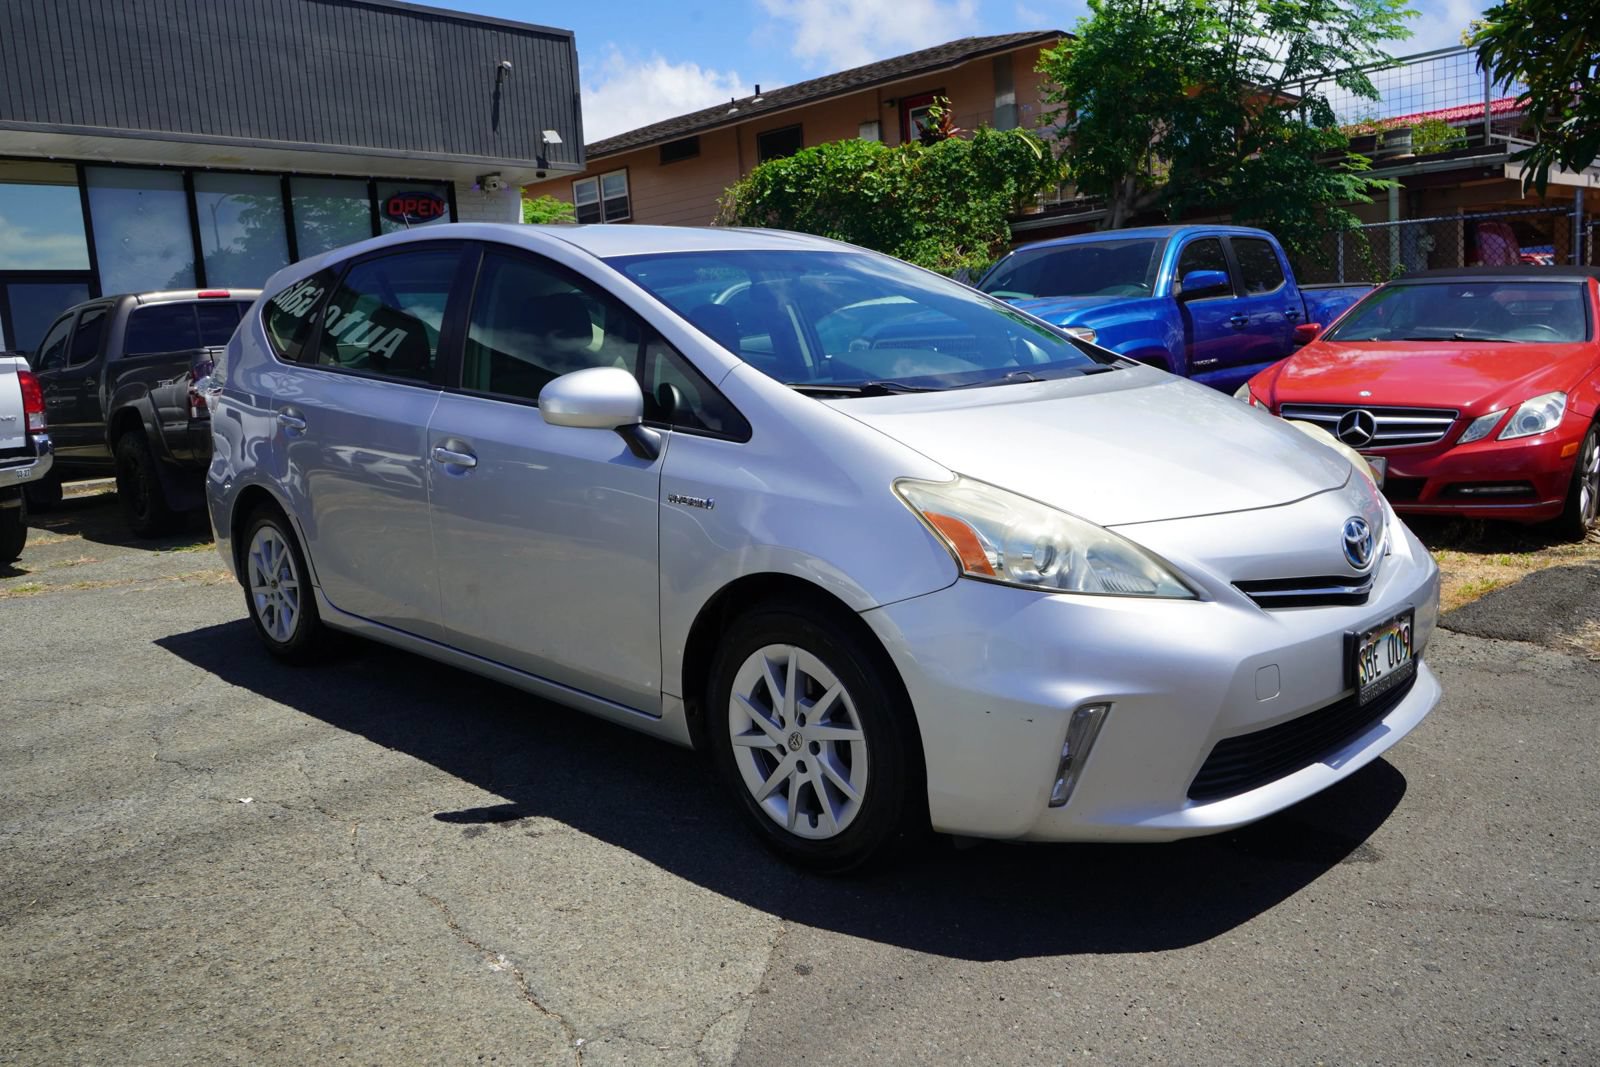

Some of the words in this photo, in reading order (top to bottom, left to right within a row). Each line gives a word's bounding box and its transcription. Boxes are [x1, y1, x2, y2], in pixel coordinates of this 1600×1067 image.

[387, 198, 445, 217] OPEN
[1359, 640, 1382, 685] SBE
[1387, 625, 1410, 668] 009
